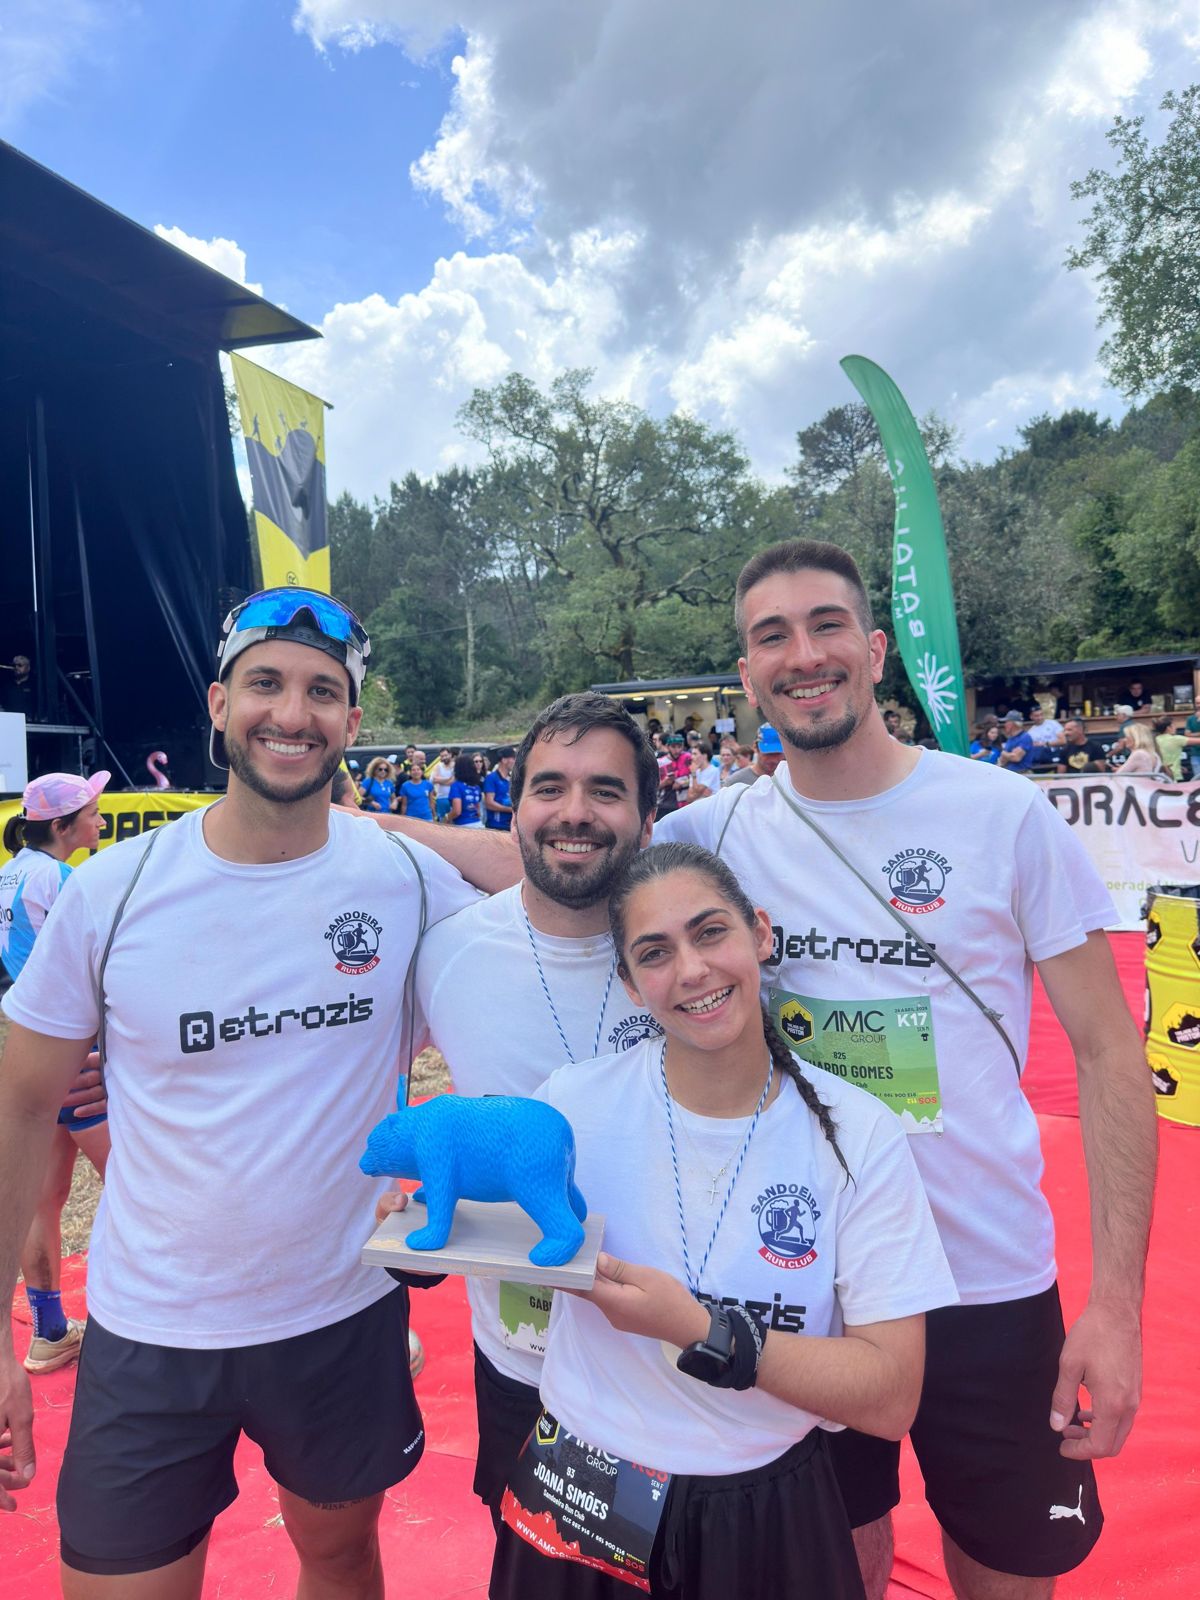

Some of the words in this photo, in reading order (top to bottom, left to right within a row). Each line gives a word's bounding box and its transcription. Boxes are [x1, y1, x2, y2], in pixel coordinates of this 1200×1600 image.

[882, 848, 952, 874] SANDOEIRA
[896, 902, 914, 912] RUN
[915, 902, 940, 913] CLUB
[324, 911, 383, 940] SANDOEIRA
[340, 965, 358, 974] RUN
[359, 960, 377, 973] CLUB
[180, 993, 373, 1053] Retrozis
[822, 1010, 886, 1033] AMC
[897, 1012, 928, 1027] K17
[850, 1034, 886, 1044] GROUP
[833, 1051, 846, 1060] 825
[851, 1065, 894, 1080] GOMES
[751, 1184, 821, 1221] SANDOEIRA
[765, 1252, 786, 1267] RUN
[787, 1254, 813, 1268] CLUB
[586, 1454, 618, 1476] GROUP
[533, 1461, 564, 1496] JOANA
[566, 1483, 609, 1520] SIMÕES
